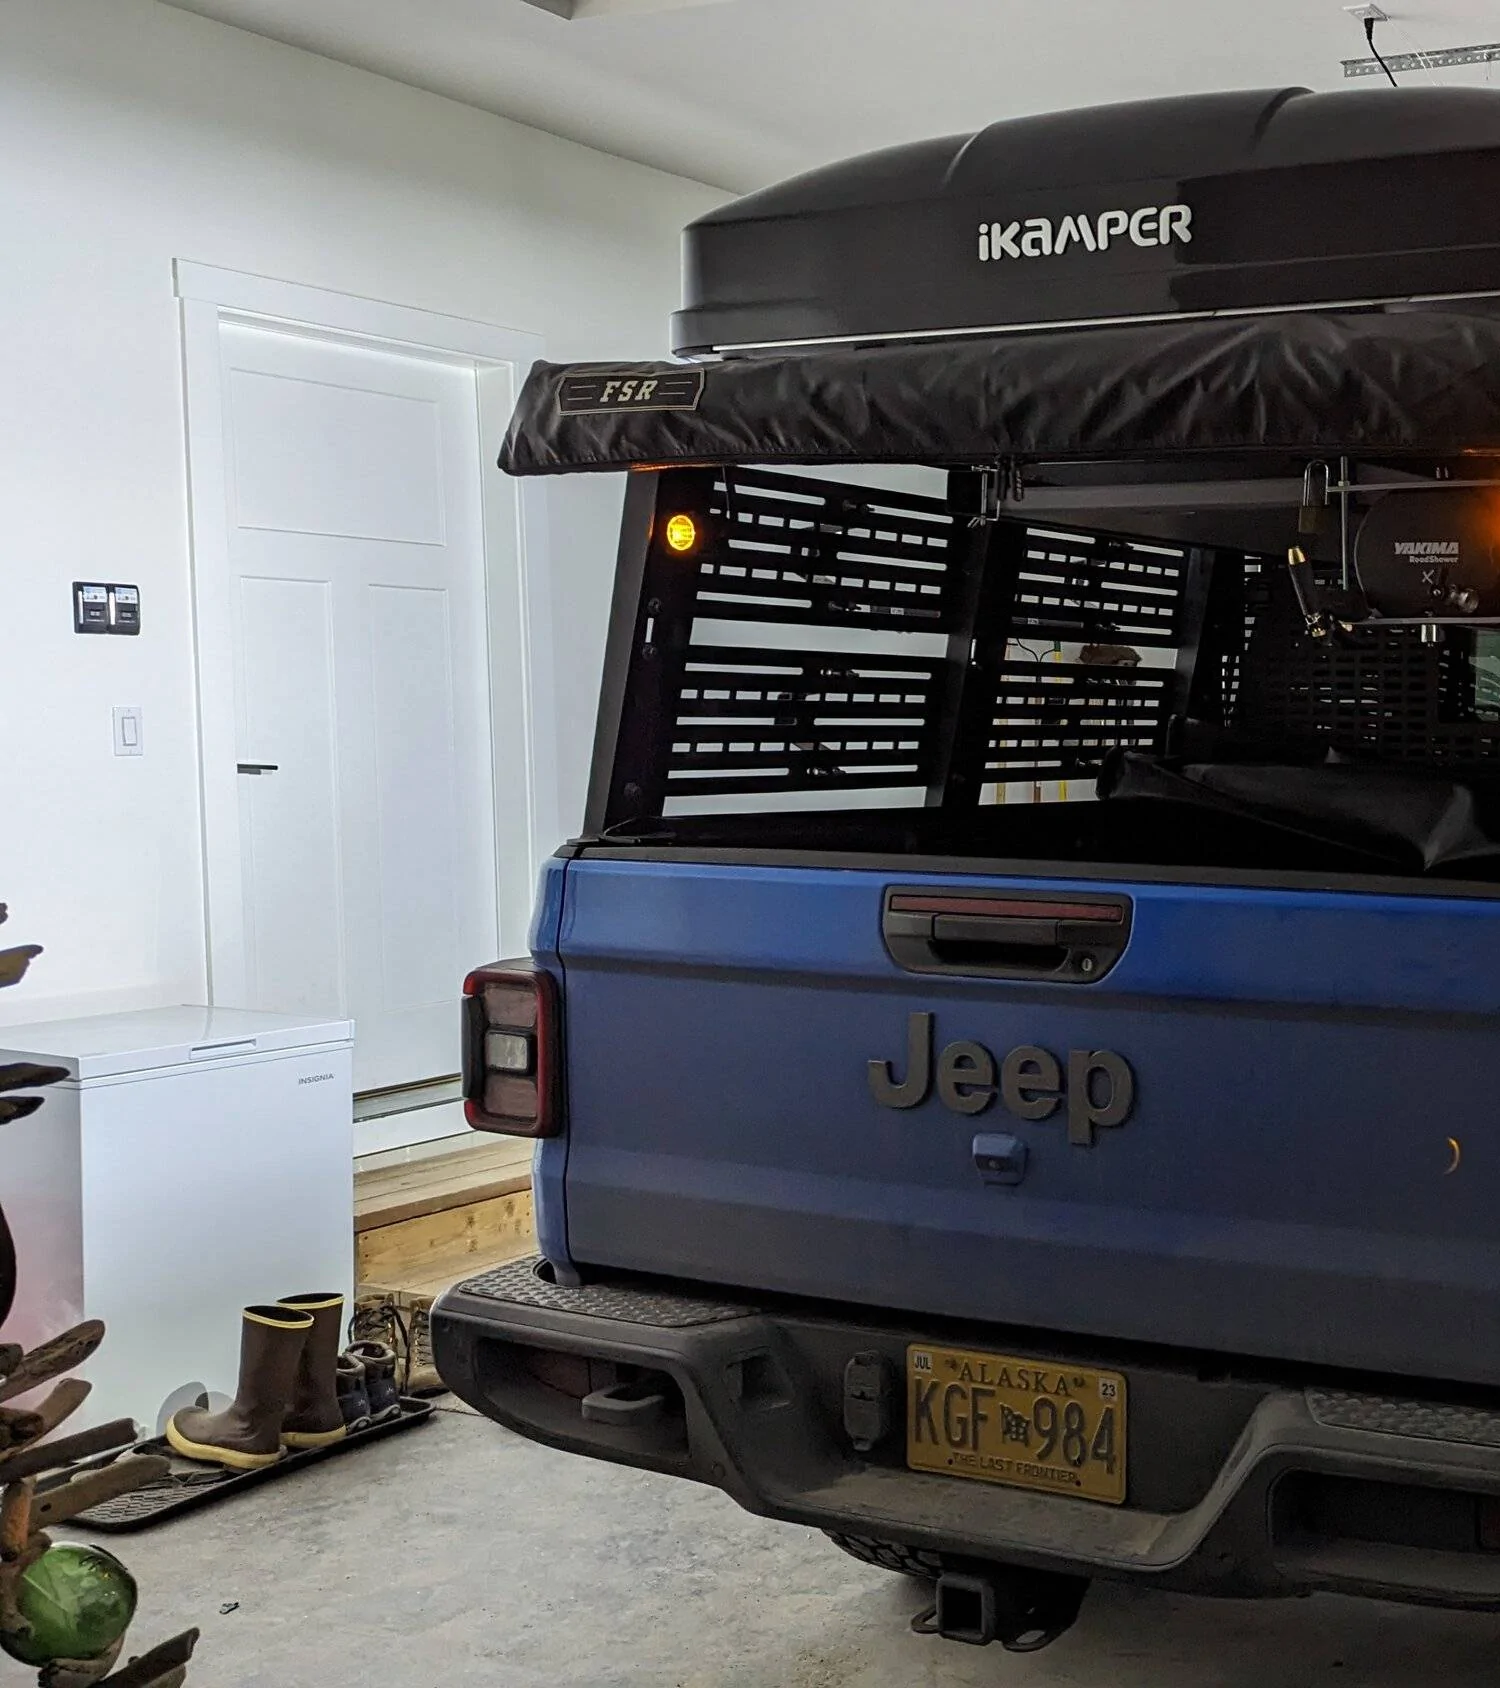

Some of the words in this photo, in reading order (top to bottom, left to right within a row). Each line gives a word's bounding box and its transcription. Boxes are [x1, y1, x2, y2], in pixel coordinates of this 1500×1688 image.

[600, 380, 658, 402] FSR
[1394, 542, 1459, 554] YAKIMA
[299, 1073, 334, 1085] INSIGNIA
[867, 1012, 1135, 1145] Jeep
[915, 1356, 931, 1369] JUL
[959, 1361, 1070, 1395] ALASKA
[1102, 1384, 1116, 1396] 23
[914, 1377, 995, 1450] KGF
[1032, 1396, 1115, 1474] 984
[953, 1453, 976, 1467] THE
[980, 1455, 1013, 1472] LAST
[1016, 1461, 1076, 1483] FRONTIER
